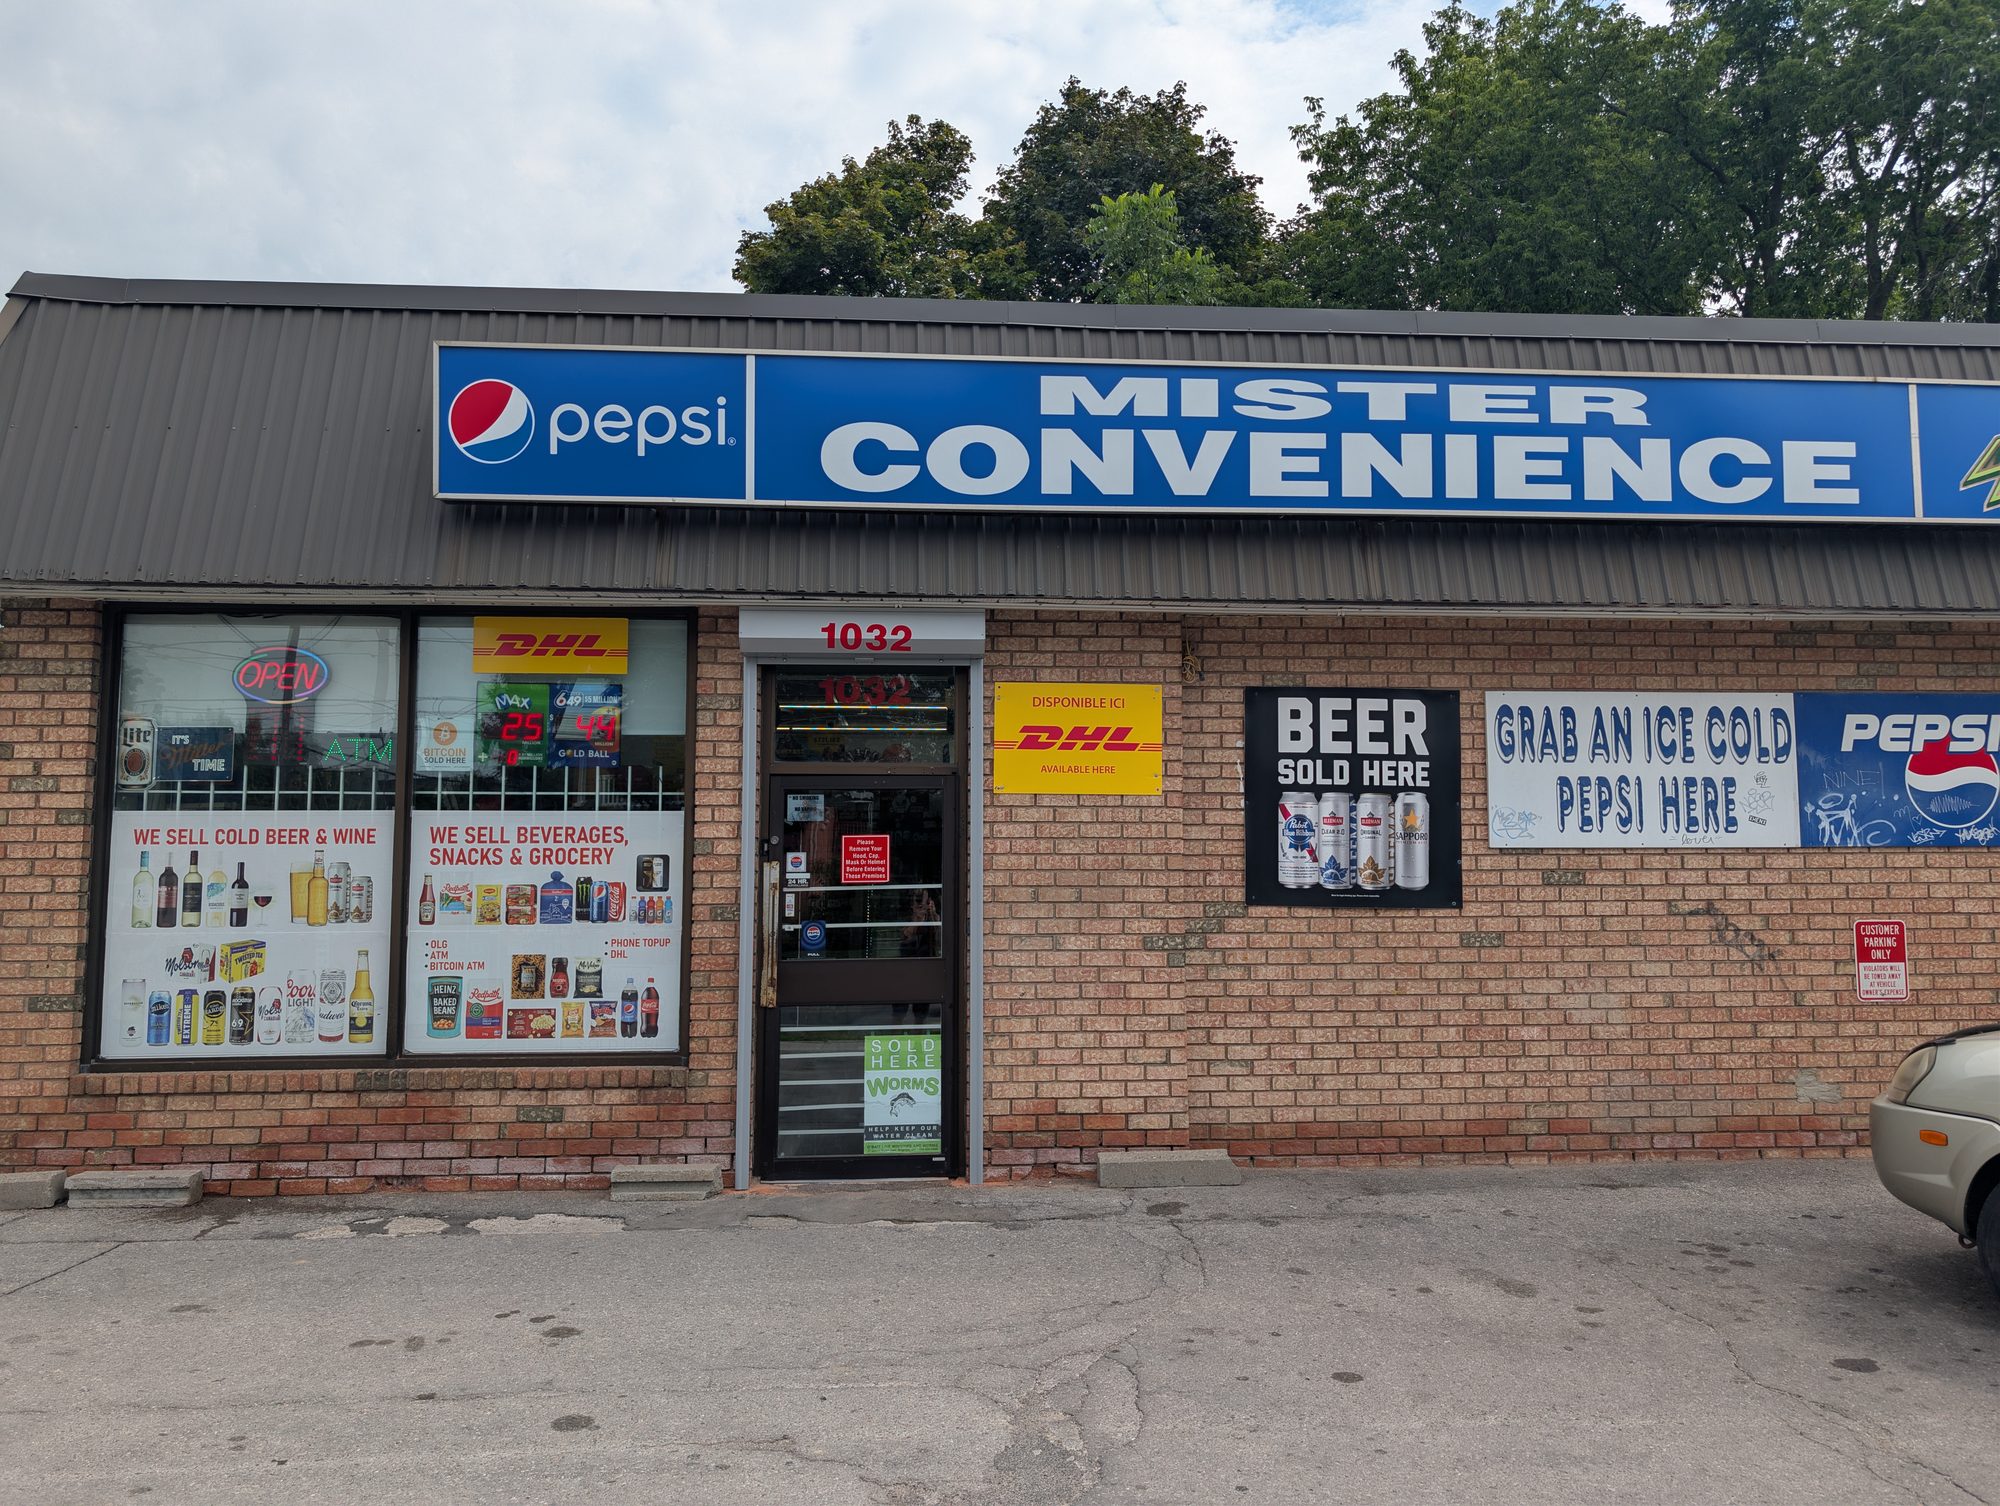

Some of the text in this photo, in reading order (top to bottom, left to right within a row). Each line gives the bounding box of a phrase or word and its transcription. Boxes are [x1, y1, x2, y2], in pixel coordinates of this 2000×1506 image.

[1040, 375, 1652, 426] MISTER
[820, 421, 1860, 505] CONVENIENCE
[820, 622, 912, 652] 1032
[494, 633, 608, 657] DHL
[238, 661, 320, 690] OPEN
[818, 675, 912, 706] 1032
[495, 693, 530, 709] MAX
[1032, 696, 1125, 709] DISPONIBLE ICI
[502, 713, 544, 740] 25
[576, 715, 617, 740] 44
[1277, 697, 1430, 756] BEER
[1494, 703, 1792, 765] GRAB AN ICE COLD
[121, 727, 152, 748] Lite
[171, 735, 190, 745] IT'S
[1016, 725, 1141, 752] DHL
[323, 738, 392, 762] ATM
[423, 747, 466, 757] BITCOIN
[588, 750, 610, 758] BALL
[192, 758, 226, 772] TIME
[424, 756, 444, 764] SOLD
[1040, 765, 1116, 774] AVAILABLE HERE
[1277, 758, 1430, 787] SOLD HERE
[1556, 774, 1644, 834] PEPSI
[1658, 775, 1739, 834] HERE
[134, 828, 377, 845] WE SELL COLD BEER & WINE
[430, 826, 629, 847] WE SELL BEVERAGES,
[429, 847, 614, 865] SNACKS & GROCERY
[1860, 924, 1900, 935] CUSTOMER
[430, 940, 448, 949] OLG
[611, 938, 671, 948] PHONE TOPUP
[1864, 937, 1897, 947] PARKING
[235, 951, 255, 966] TWISTED
[430, 951, 449, 960] ATM
[611, 949, 628, 959] DHL
[1871, 949, 1891, 960] ONLY
[430, 961, 485, 971] BITCOIN ATM
[433, 984, 457, 994] HEINZ
[469, 988, 502, 1001] Redpath
[287, 997, 314, 1007] LIGHT
[433, 997, 457, 1006] BAKED
[433, 1006, 456, 1015] BEANS
[182, 1004, 191, 1039] EXTREME
[871, 1038, 935, 1053] SOLD
[871, 1054, 936, 1068] HERE
[867, 1076, 940, 1098] WORMS
